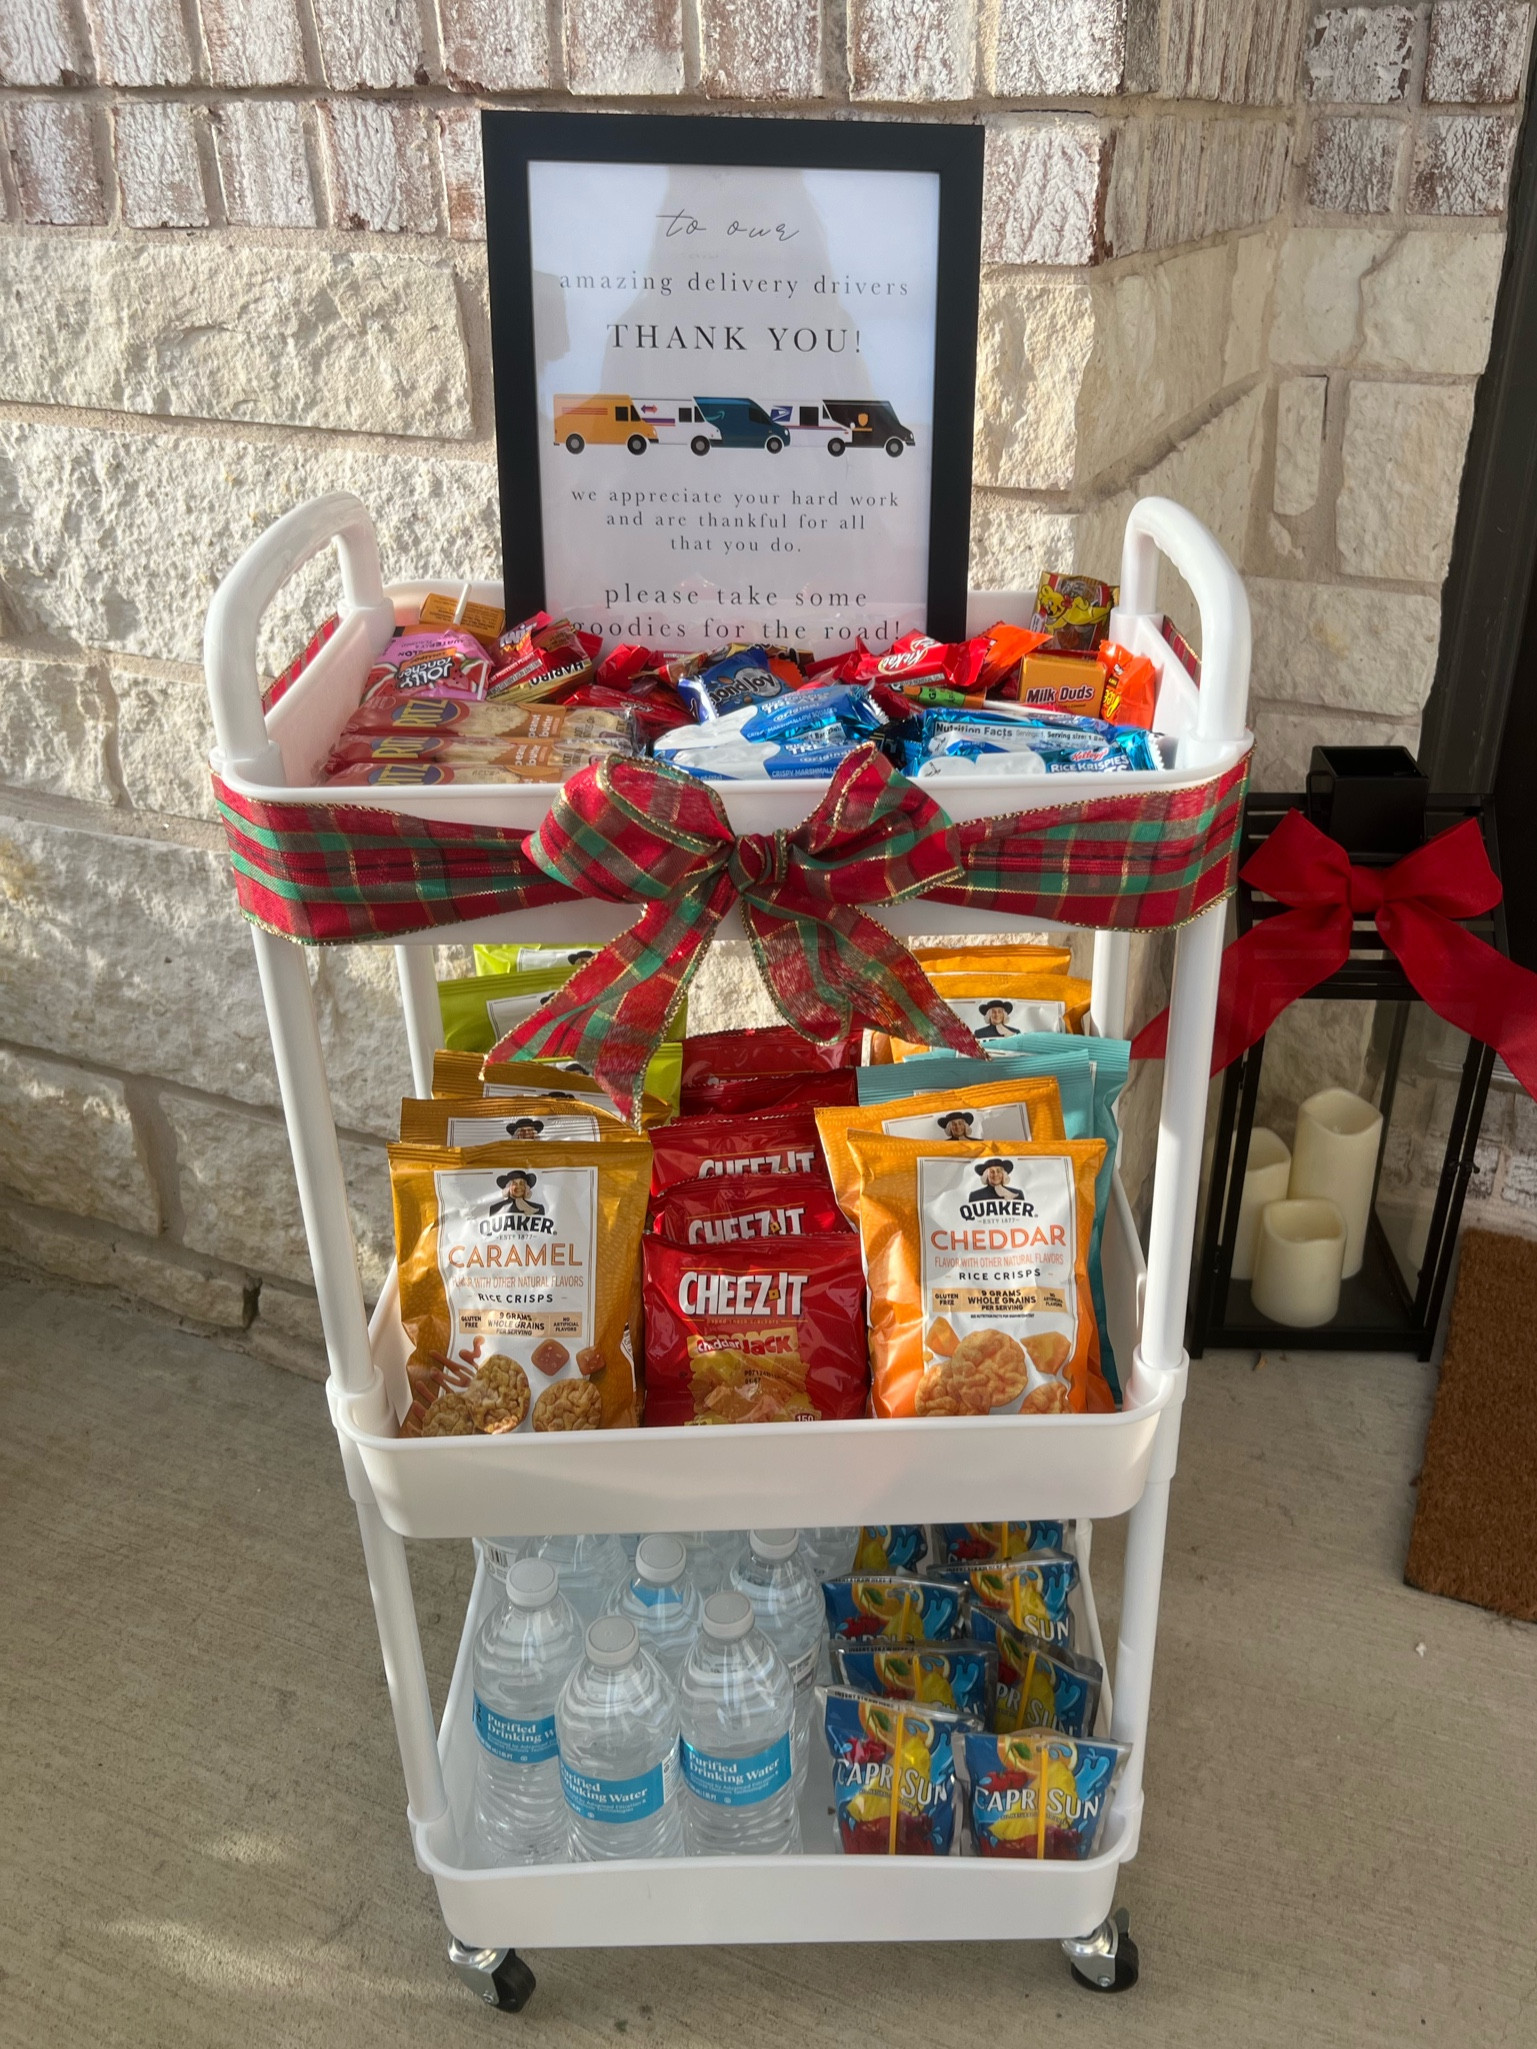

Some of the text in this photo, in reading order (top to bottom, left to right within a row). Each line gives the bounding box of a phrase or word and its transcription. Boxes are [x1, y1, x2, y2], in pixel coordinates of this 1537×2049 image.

[656, 208, 800, 242] to our
[559, 270, 909, 299] amazing delivery drivers
[606, 323, 863, 353] THANK YOU!
[571, 488, 900, 508] we appreciate your hard work
[606, 511, 867, 530] and are thankful for all
[670, 536, 802, 556] that you do.
[605, 582, 868, 609] please take some
[703, 617, 745, 638] for
[763, 619, 807, 640] the
[823, 619, 901, 641] road!
[400, 663, 453, 688] JOLLY
[1027, 684, 1095, 705] Milk Duds
[393, 699, 449, 729] RITZ
[935, 722, 981, 736] Nutrition
[983, 726, 1013, 738] Facts
[1051, 762, 1077, 773] RICE
[1077, 756, 1130, 772] KRISPIES
[959, 1200, 1035, 1222] QUAKER
[479, 1215, 555, 1236] QUAKER
[930, 1224, 1067, 1252] CHEDDAR
[448, 1243, 583, 1269] CARAMEL
[934, 1252, 1064, 1269] FLAVOR WITH OTHER NATURAL FLAVORS
[474, 1276, 491, 1289] WITH
[492, 1276, 516, 1289] OTHER
[517, 1275, 550, 1288] NATURAL
[551, 1275, 584, 1288] FLAVORS
[959, 1268, 1041, 1281] RICE CRISPS
[478, 1293, 554, 1304] RICE CRISPS
[967, 1295, 1037, 1305] WHOLE GRAINS
[989, 1289, 1022, 1298] GRAMS
[505, 1312, 533, 1322] GRAMS
[981, 1304, 1024, 1312] PER SERVING
[464, 1321, 479, 1329] FREE
[487, 1319, 545, 1331] WHOLE GRAINS
[1023, 1614, 1070, 1642] SUN
[487, 1713, 537, 1734] Purified
[487, 1725, 543, 1744] Drinking
[689, 1751, 738, 1774] Purified
[690, 1762, 744, 1785] Drinking
[746, 1758, 780, 1781] Water
[608, 1787, 648, 1804] Water
[901, 1769, 948, 1807] SUN
[1046, 1787, 1100, 1819] SUN
